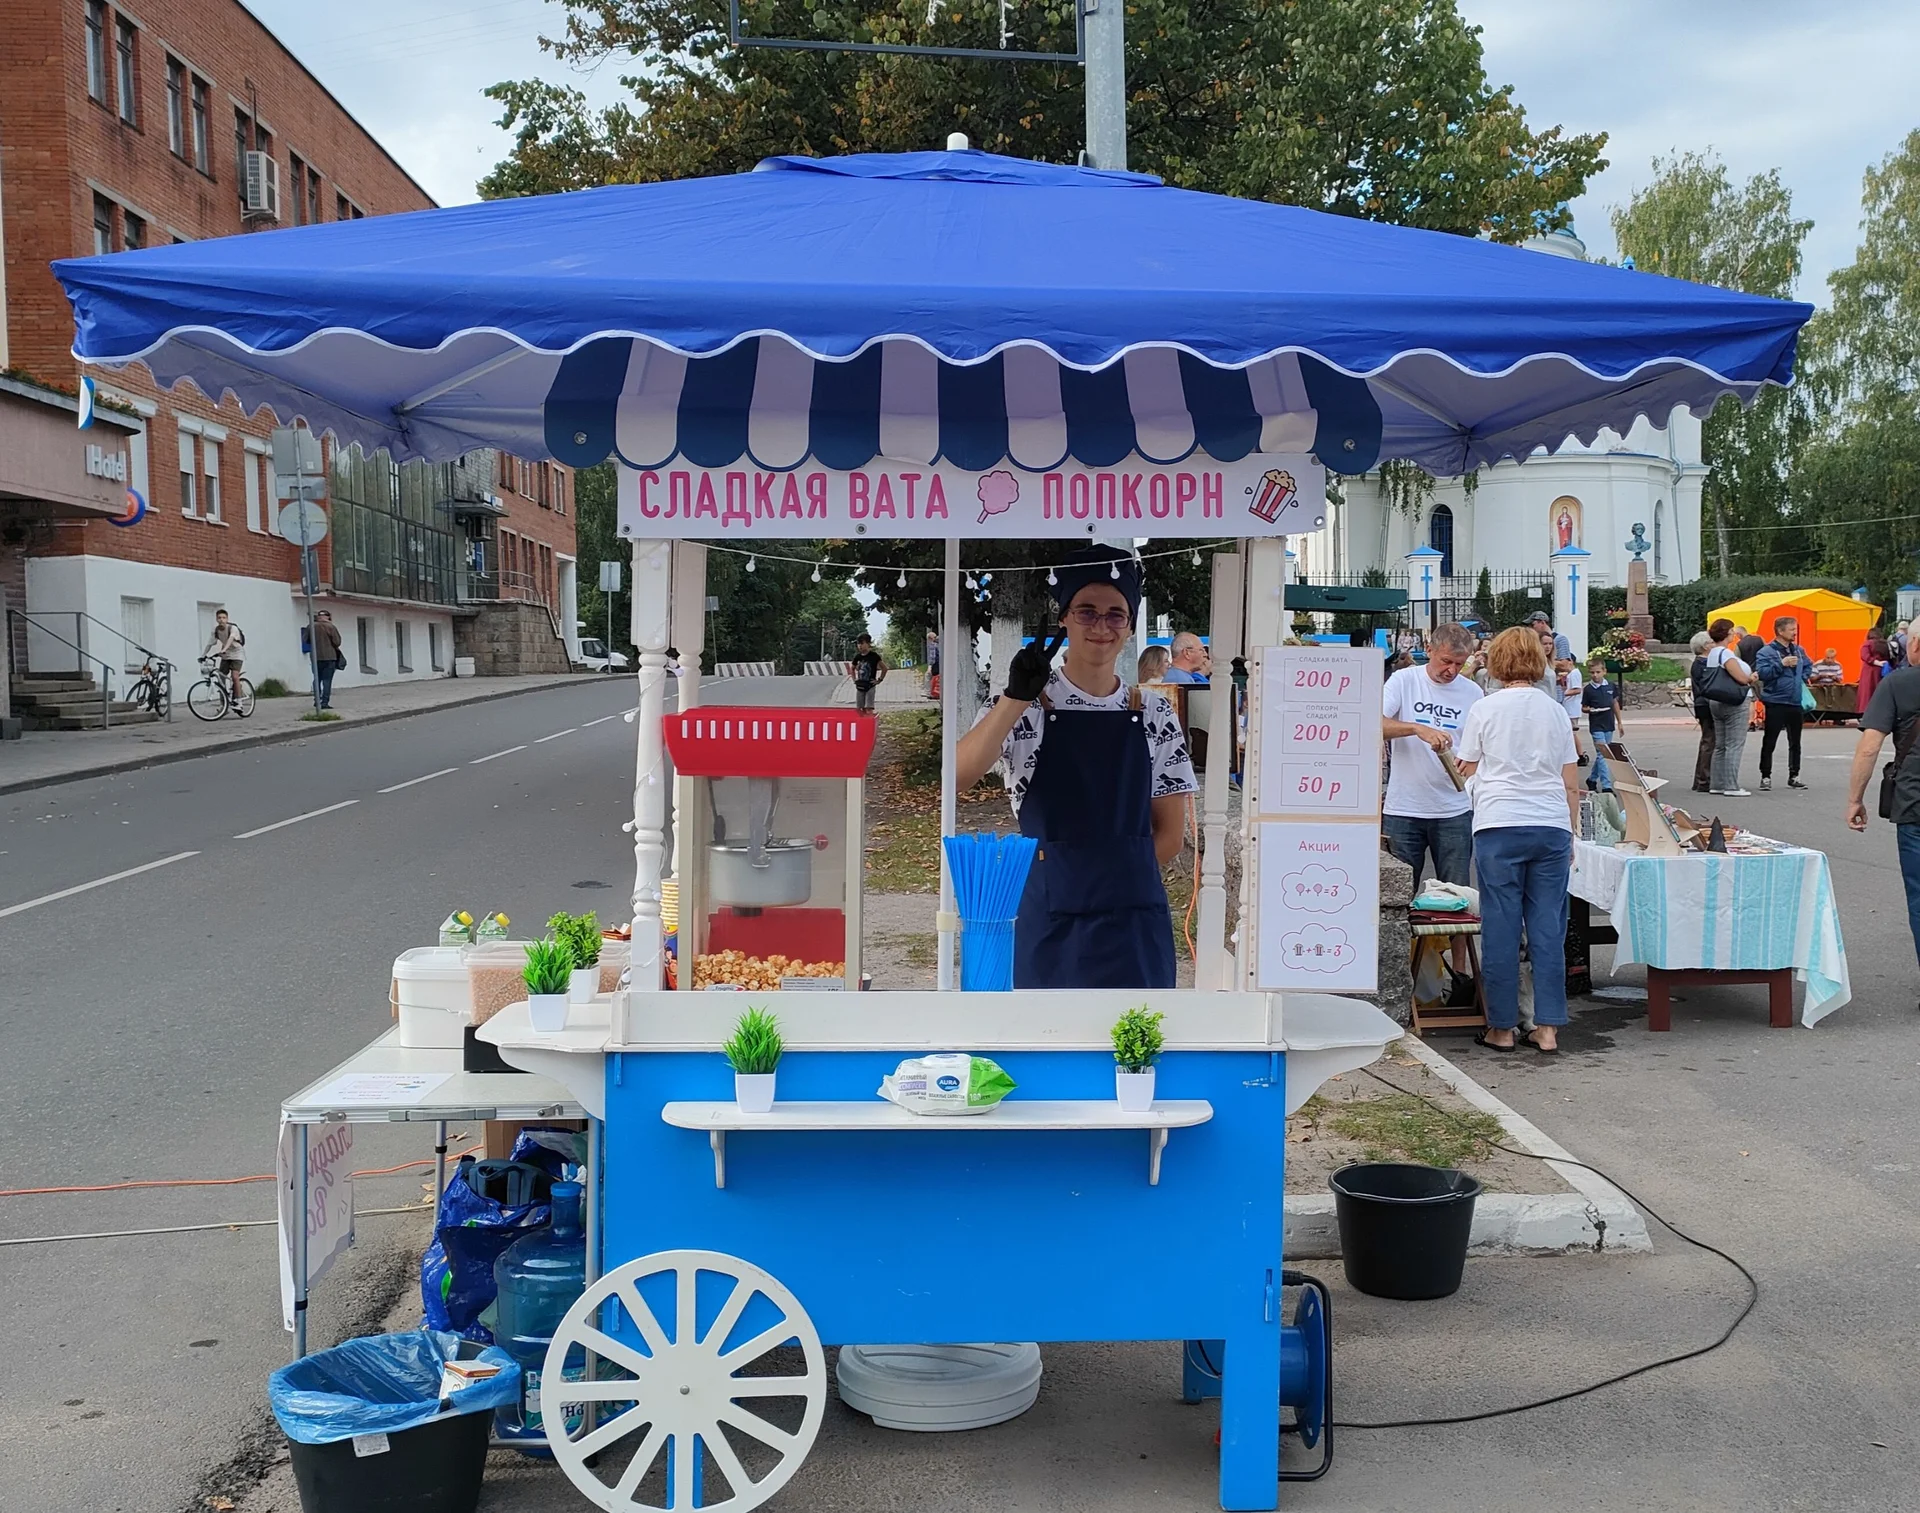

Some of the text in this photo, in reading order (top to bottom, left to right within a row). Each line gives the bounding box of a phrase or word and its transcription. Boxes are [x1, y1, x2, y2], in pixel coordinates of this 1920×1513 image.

[86, 444, 127, 482] Hotel
[639, 471, 1223, 527] СЛАДКАЯ ВАТА ПОПКОРН
[1295, 670, 1332, 687] 200
[1414, 701, 1462, 720] OAKLEY
[1294, 724, 1331, 741] 200
[1153, 782, 1193, 797] adidas
[1299, 776, 1322, 793] 50
[1298, 841, 1340, 853] Акции
